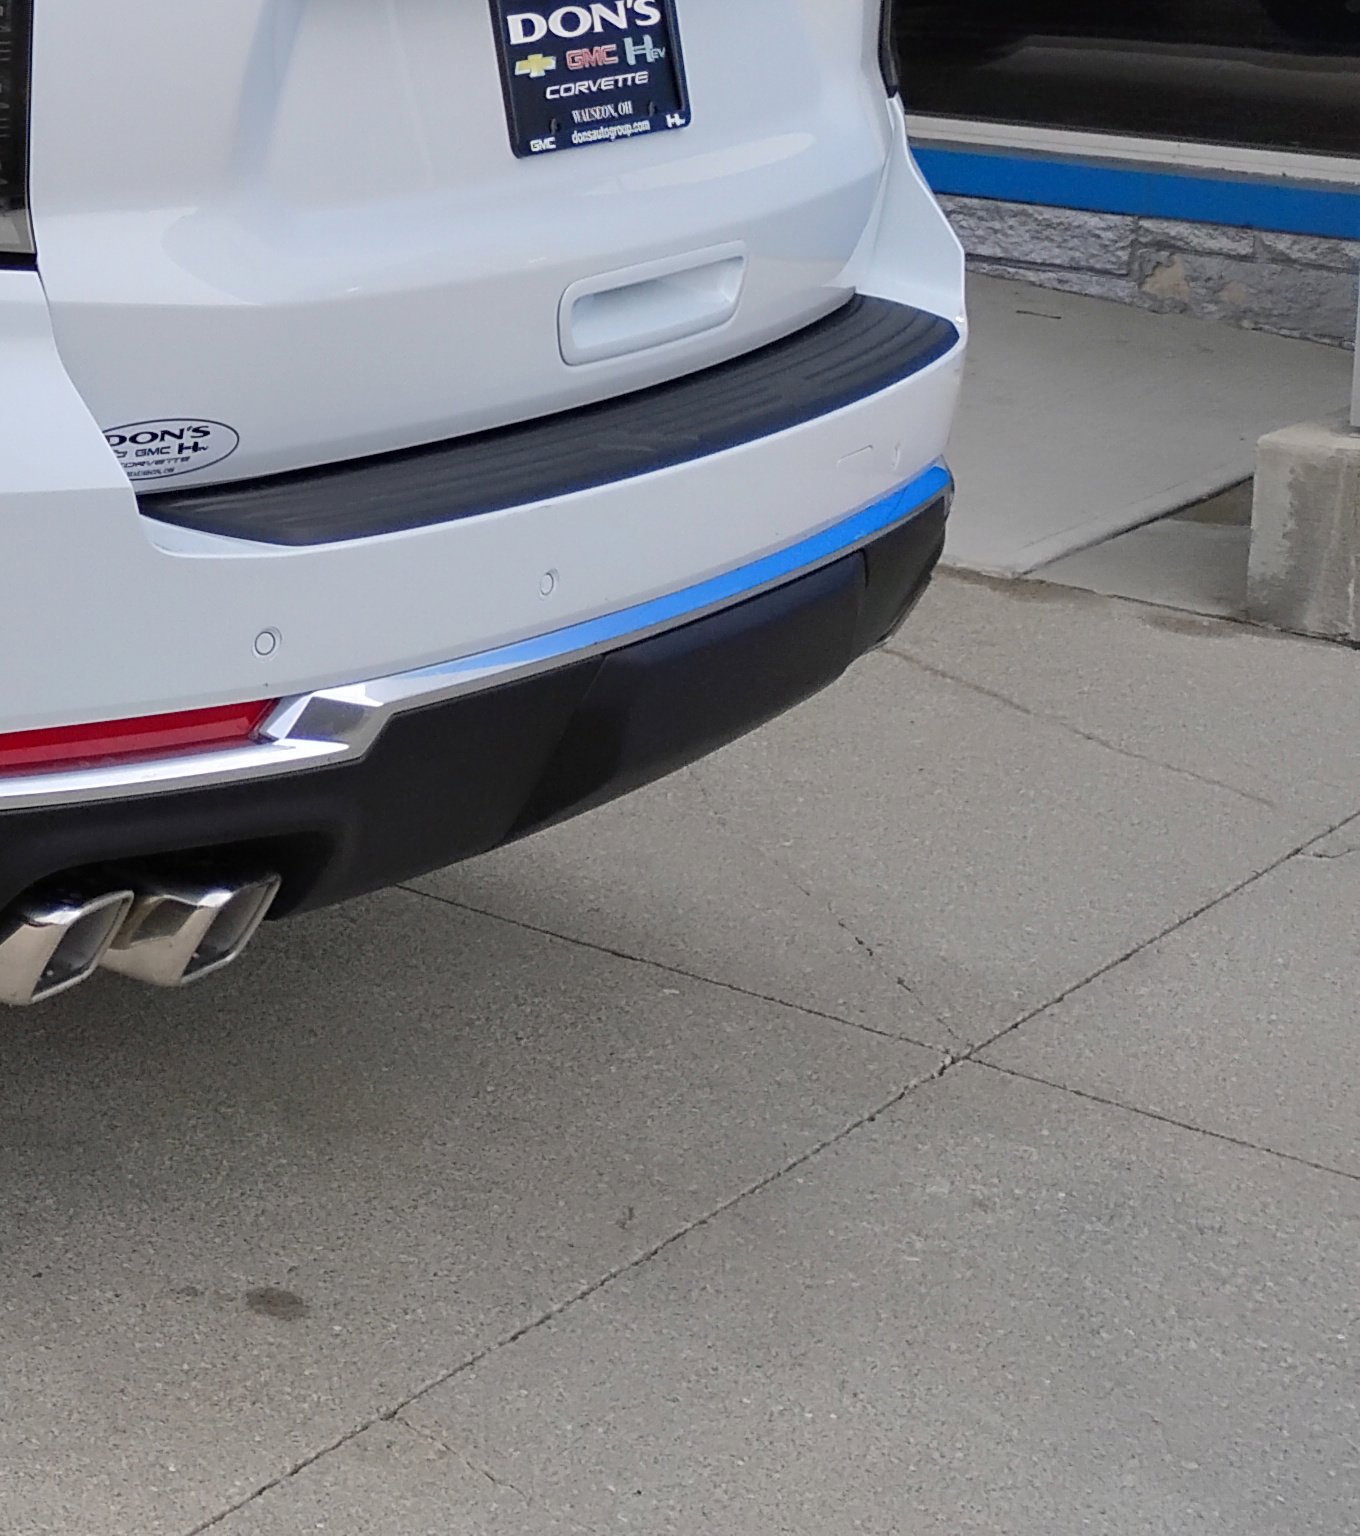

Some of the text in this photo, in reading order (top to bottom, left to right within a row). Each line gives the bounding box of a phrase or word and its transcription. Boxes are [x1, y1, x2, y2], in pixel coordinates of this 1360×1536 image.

[566, 44, 619, 71] GMC
[545, 71, 650, 100] CORVETTE
[618, 100, 634, 116] OH
[105, 425, 211, 447] DON'S
[135, 446, 170, 458] GMC
